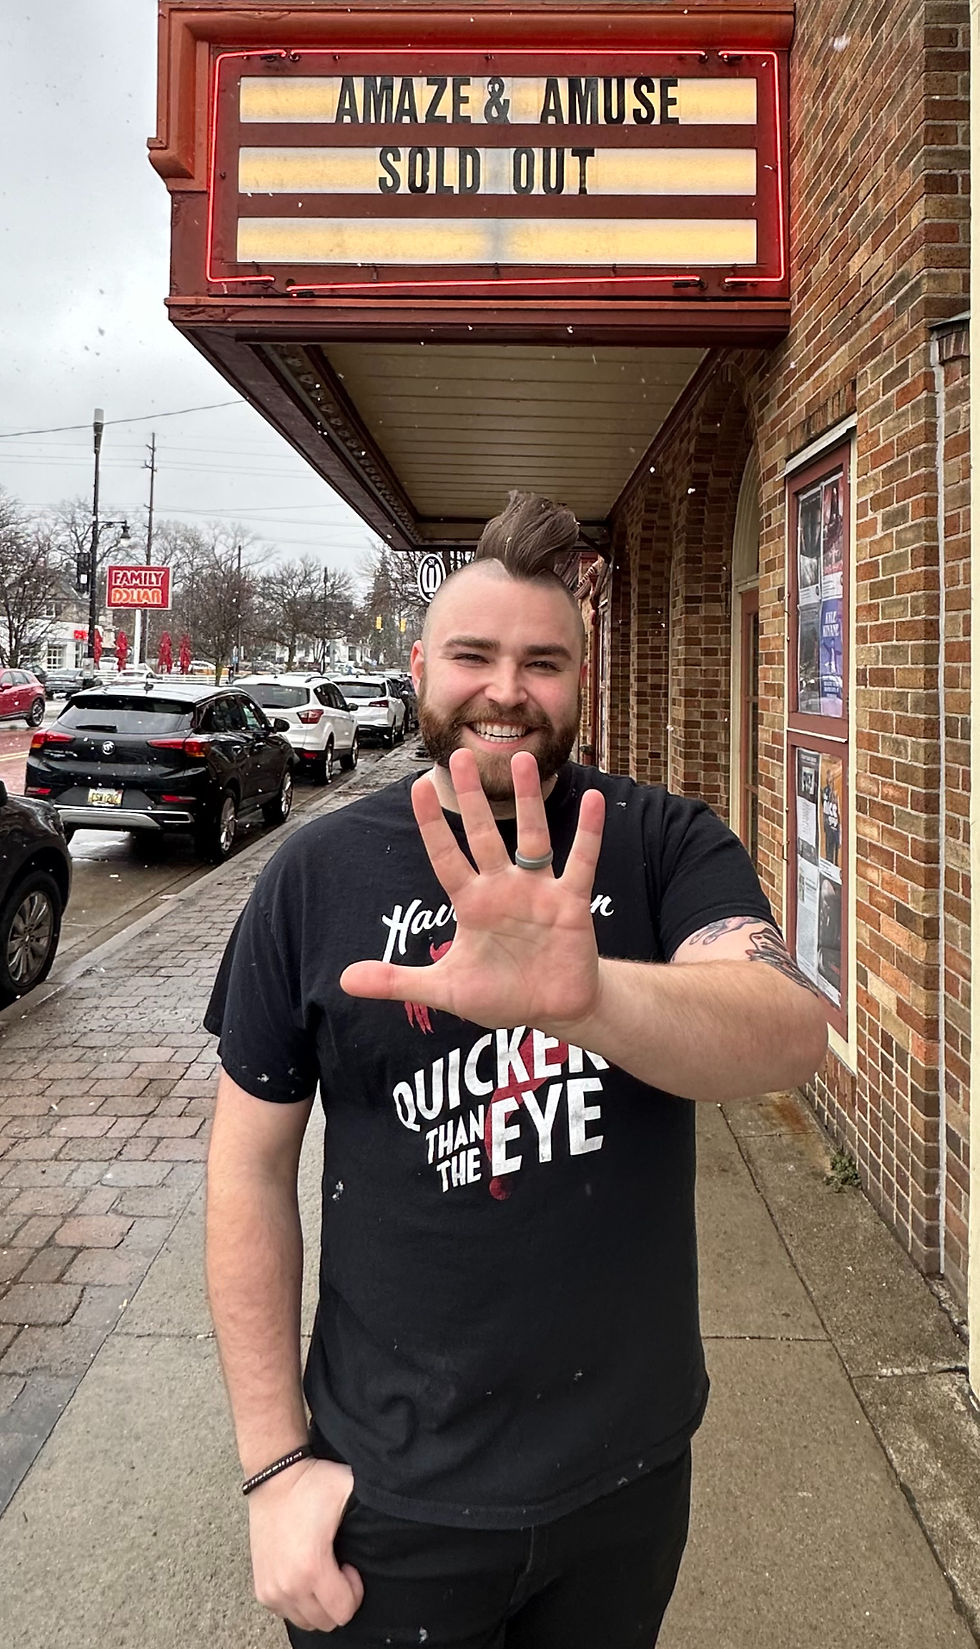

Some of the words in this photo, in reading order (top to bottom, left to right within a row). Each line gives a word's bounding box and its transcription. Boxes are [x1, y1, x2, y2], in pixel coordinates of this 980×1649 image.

[335, 77, 472, 124] AMAZE
[484, 77, 511, 124] &
[540, 78, 680, 125] AMUSE
[378, 147, 481, 194] SOLD
[513, 148, 595, 195] OUT
[111, 587, 162, 604] DOLLAR
[112, 570, 165, 586] FAMILY
[425, 1104, 485, 1165] THAN
[436, 1147, 482, 1193] THE
[491, 1077, 604, 1177] EYE
